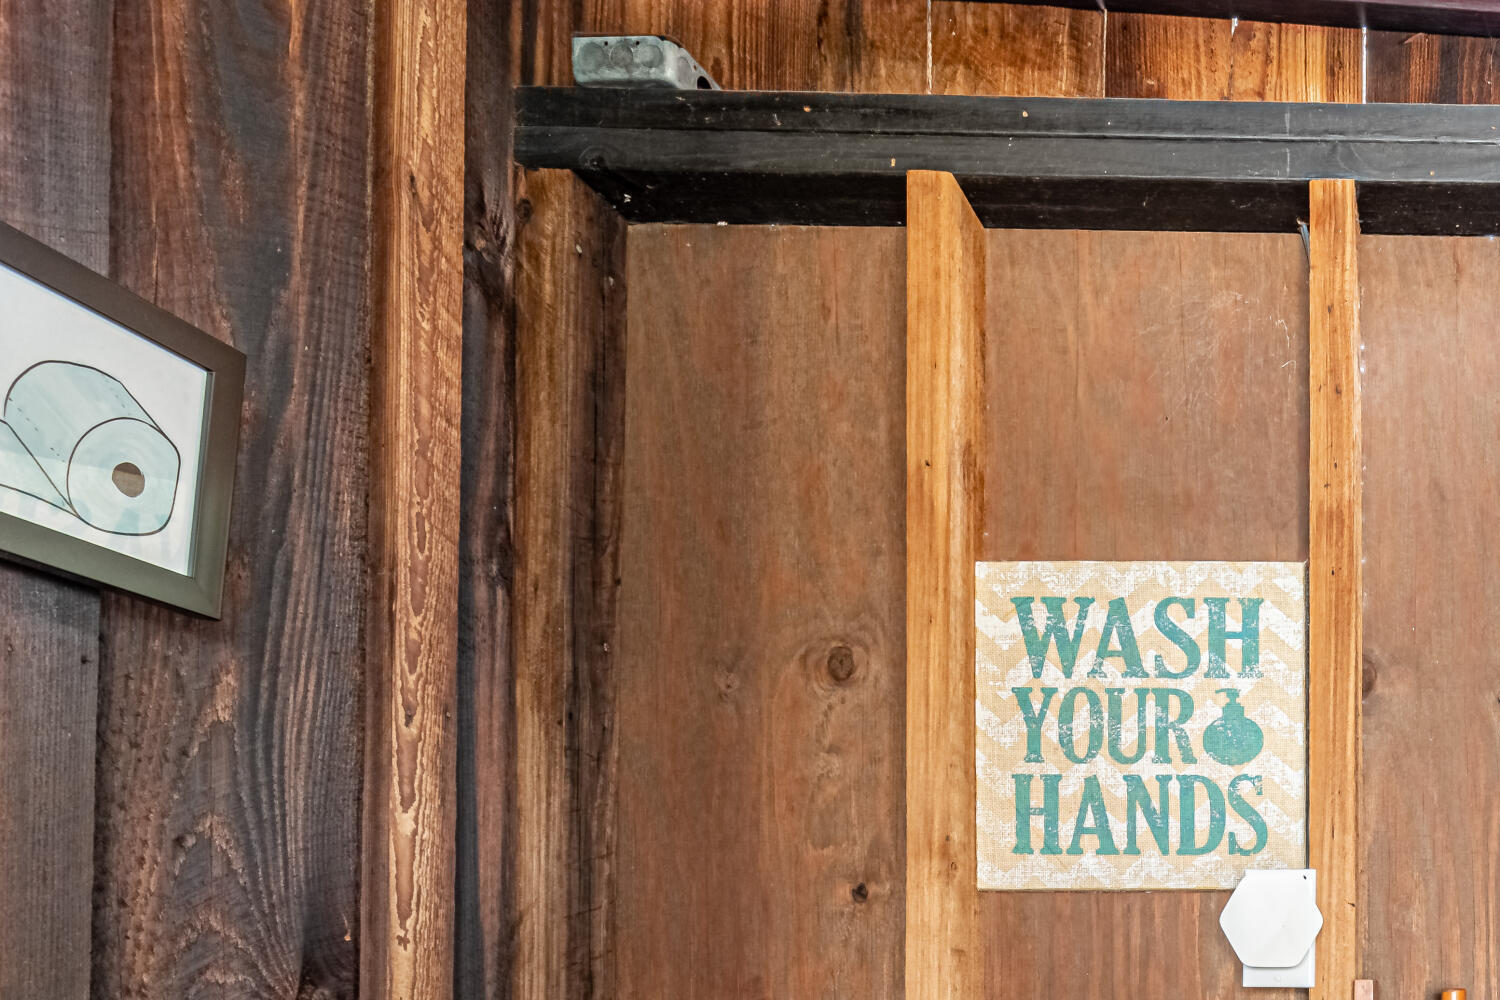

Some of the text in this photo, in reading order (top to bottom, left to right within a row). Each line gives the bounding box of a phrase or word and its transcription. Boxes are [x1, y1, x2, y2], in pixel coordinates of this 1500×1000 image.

[1010, 596, 1264, 679] WASH
[1011, 687, 1198, 765] YOUR
[1011, 774, 1269, 857] HANDS
